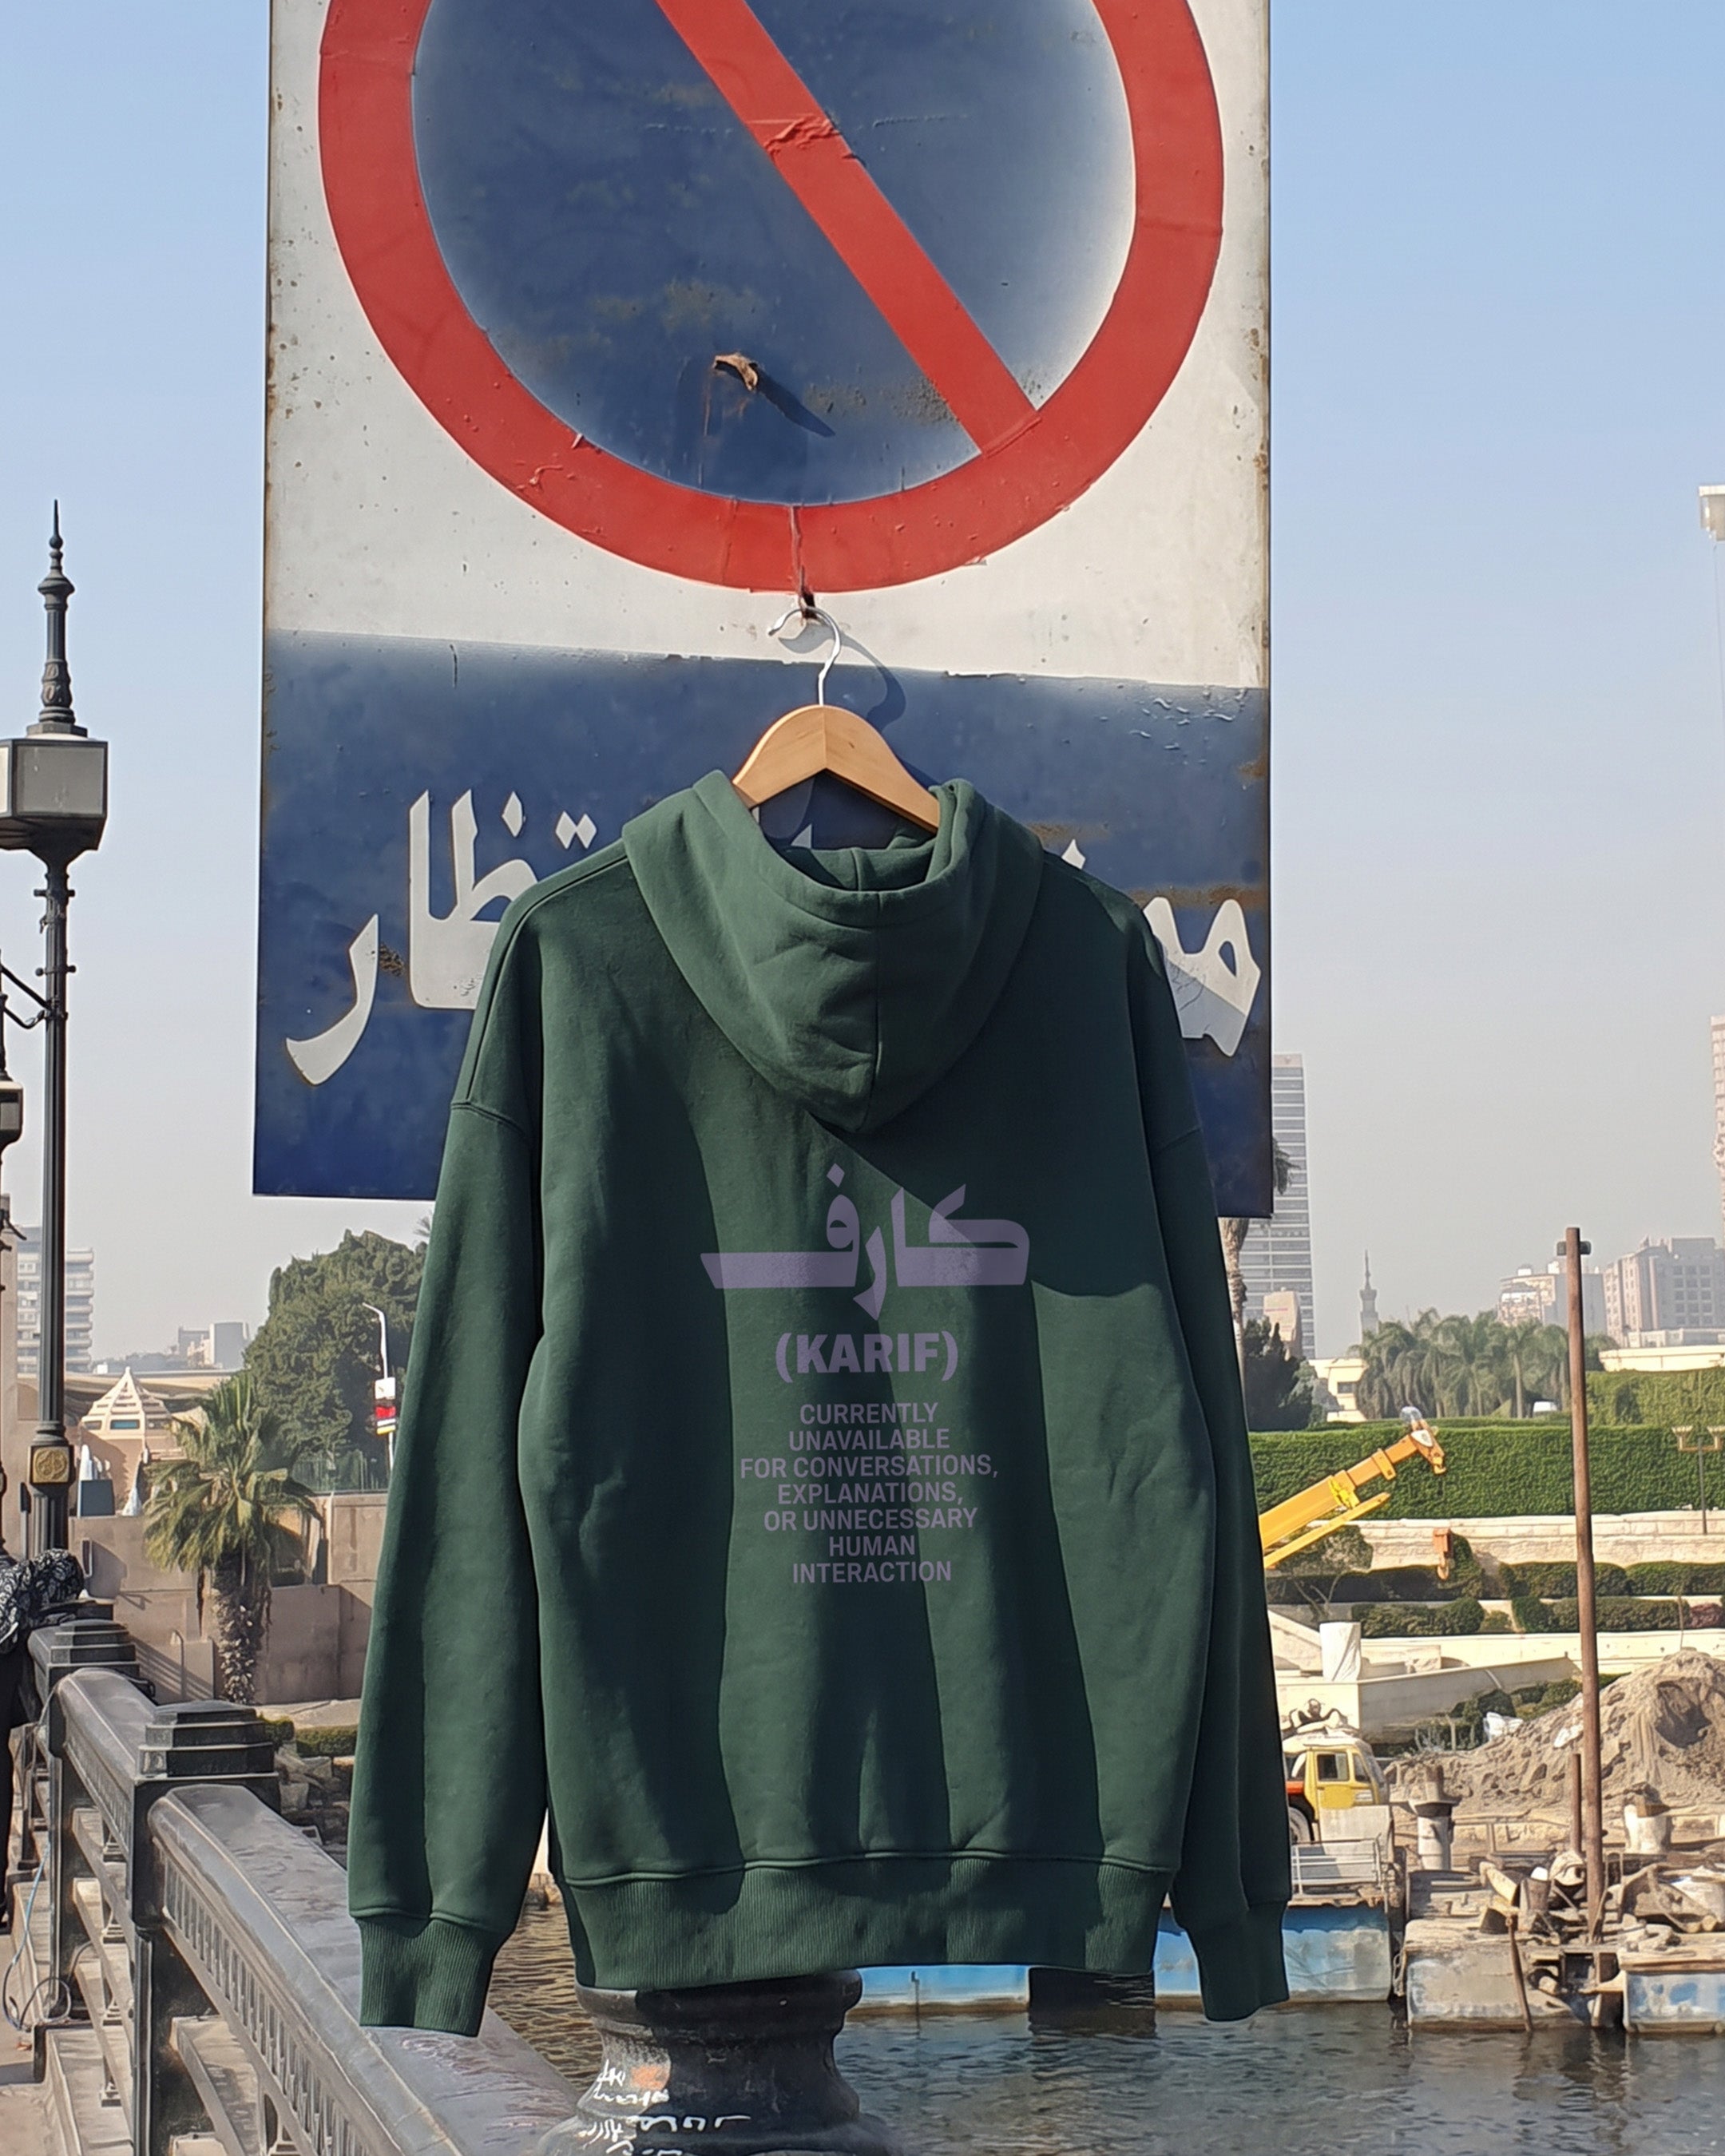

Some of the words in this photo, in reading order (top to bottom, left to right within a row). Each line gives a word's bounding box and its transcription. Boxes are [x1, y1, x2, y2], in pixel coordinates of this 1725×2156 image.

[775, 1331, 958, 1383] (KARIF)
[800, 1402, 938, 1425] CURRENTLY
[789, 1429, 950, 1451] UNAVAILABLE
[740, 1458, 787, 1478] FOR
[794, 1454, 998, 1477] CONVERSATIONS,
[778, 1481, 962, 1505] EXPLANATIONS,
[764, 1511, 796, 1532] OR
[803, 1508, 978, 1531] UNNECESSARY
[830, 1536, 915, 1557] HUMAN
[793, 1561, 950, 1583] INTERACTION
